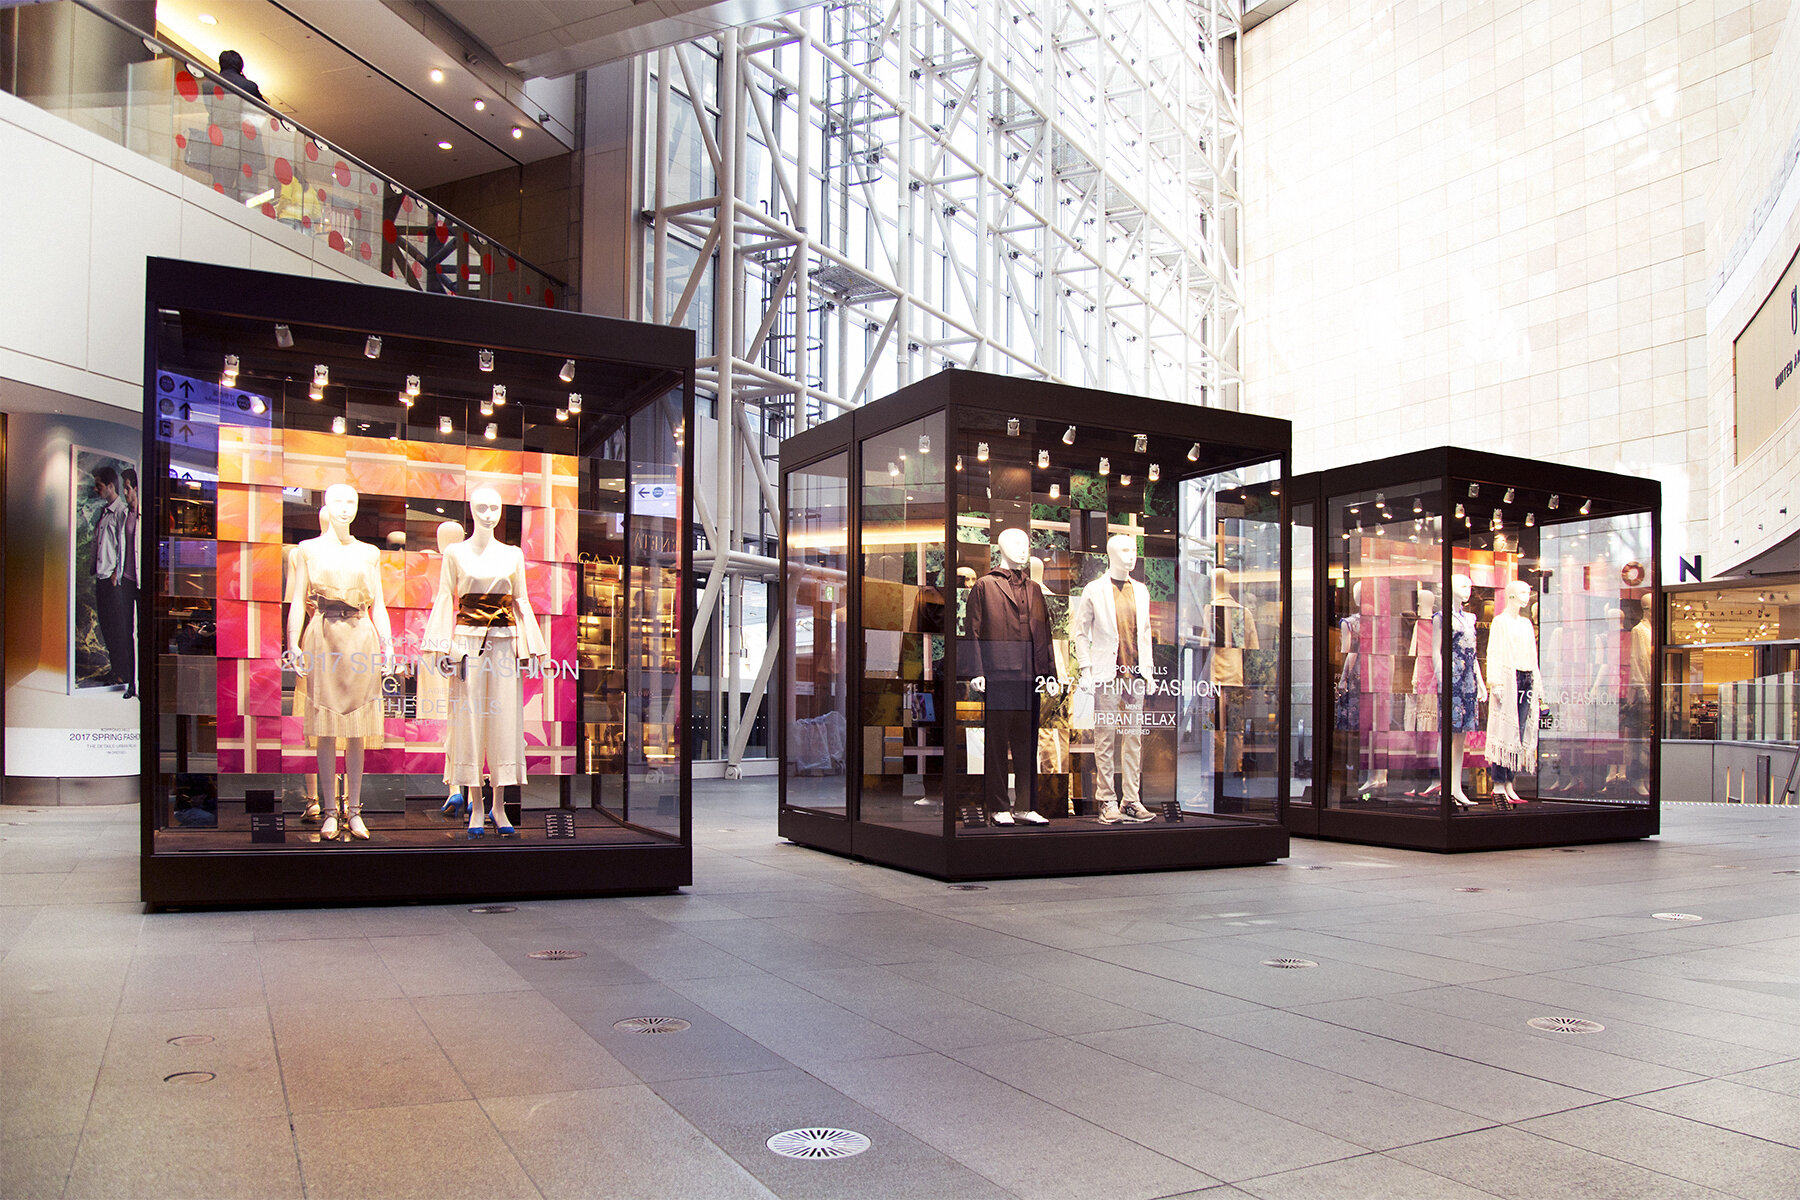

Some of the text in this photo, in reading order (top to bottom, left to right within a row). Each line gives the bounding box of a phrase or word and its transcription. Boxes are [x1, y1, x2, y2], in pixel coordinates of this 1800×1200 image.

[281, 650, 580, 680] 2017 SPRING FASHION
[374, 698, 502, 715] THE DETAILS
[1136, 713, 1176, 726] RELAX
[69, 733, 90, 741] 2017
[92, 733, 122, 741] SPRING
